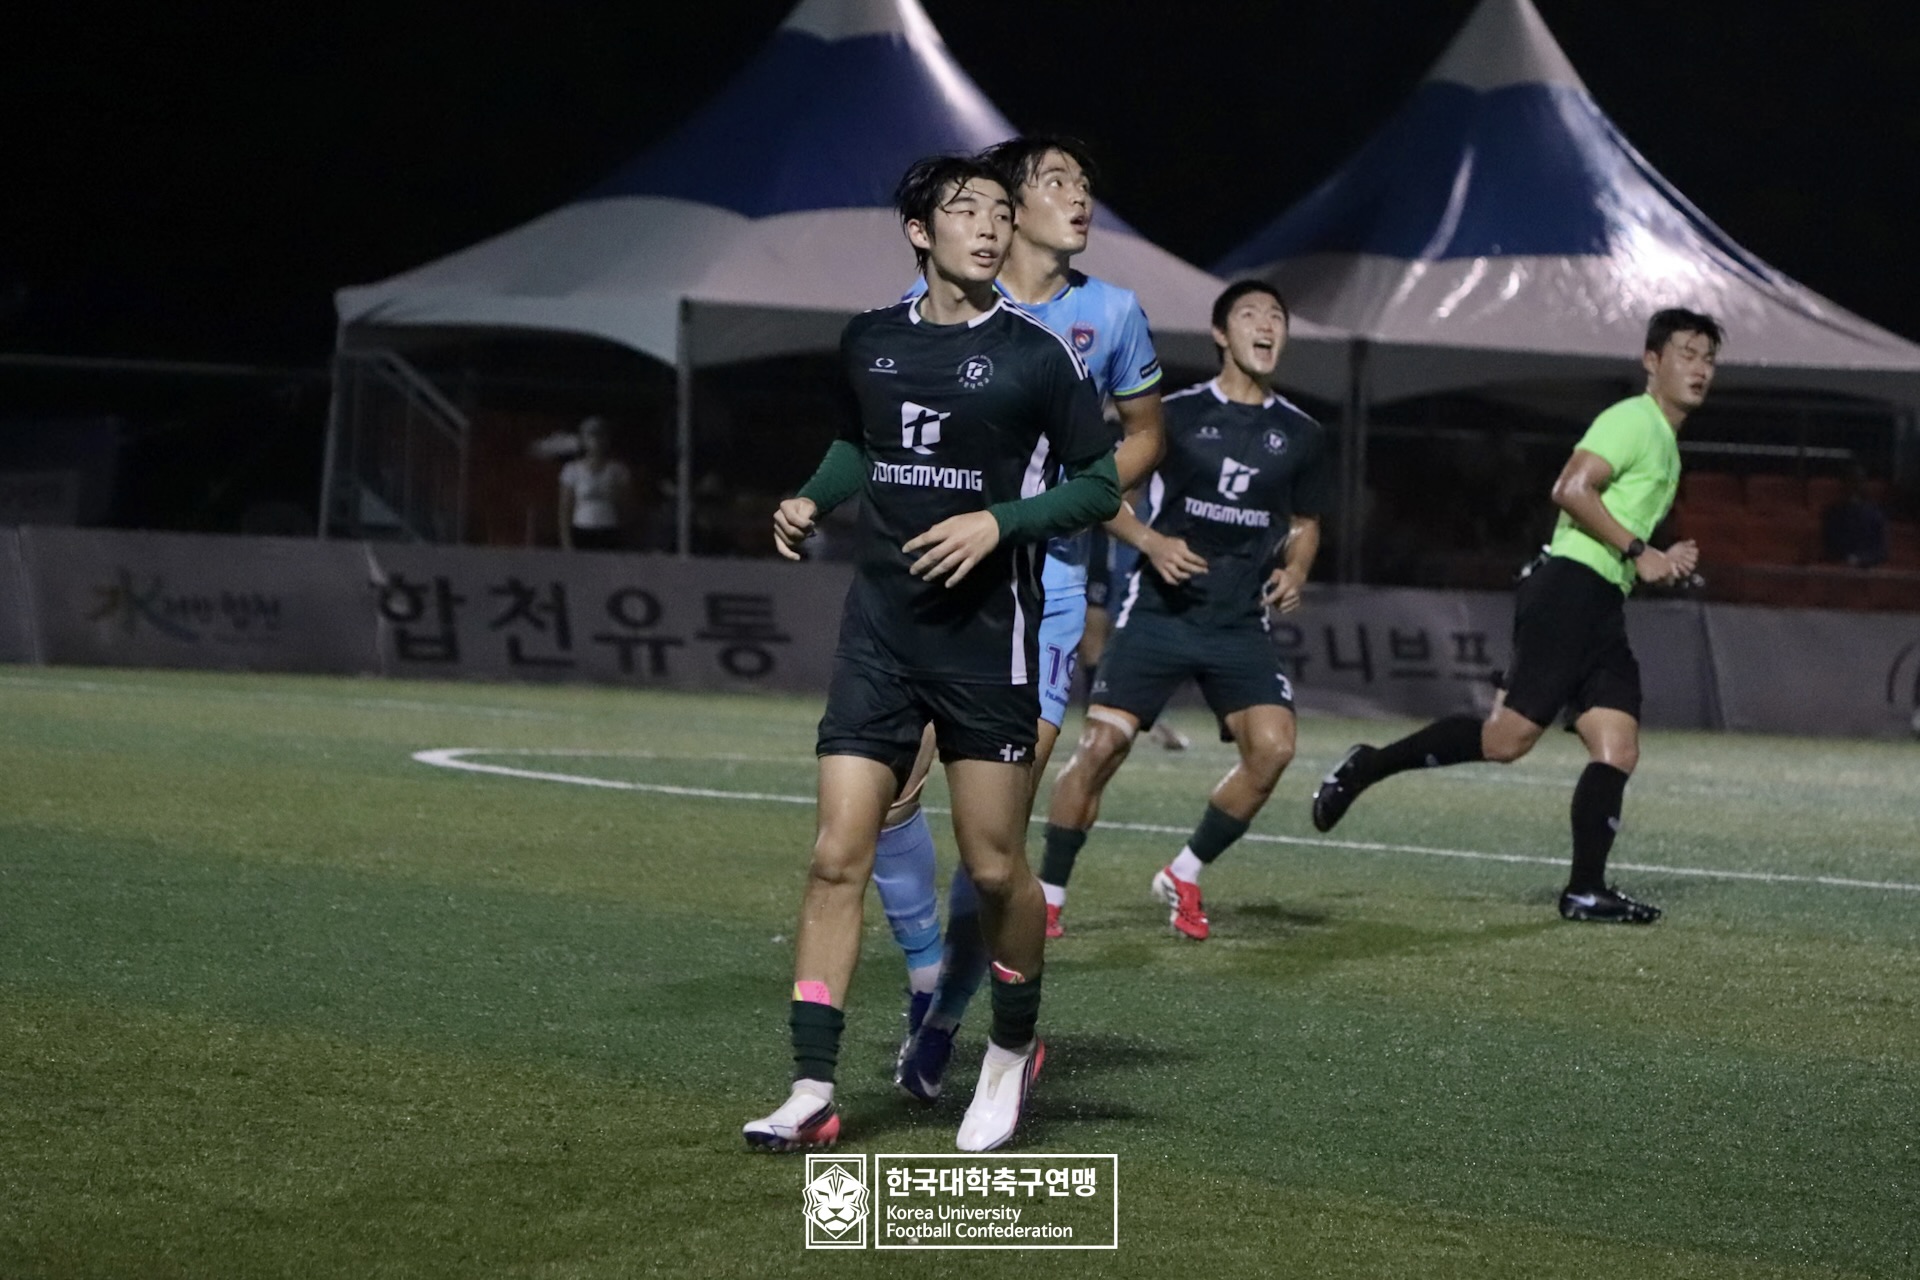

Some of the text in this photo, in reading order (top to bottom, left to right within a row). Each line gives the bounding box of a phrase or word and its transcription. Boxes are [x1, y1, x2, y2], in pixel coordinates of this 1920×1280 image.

[872, 461, 982, 492] TONGMYONG
[1184, 497, 1271, 528] TONGMYONG
[370, 573, 791, 678] 합천유통
